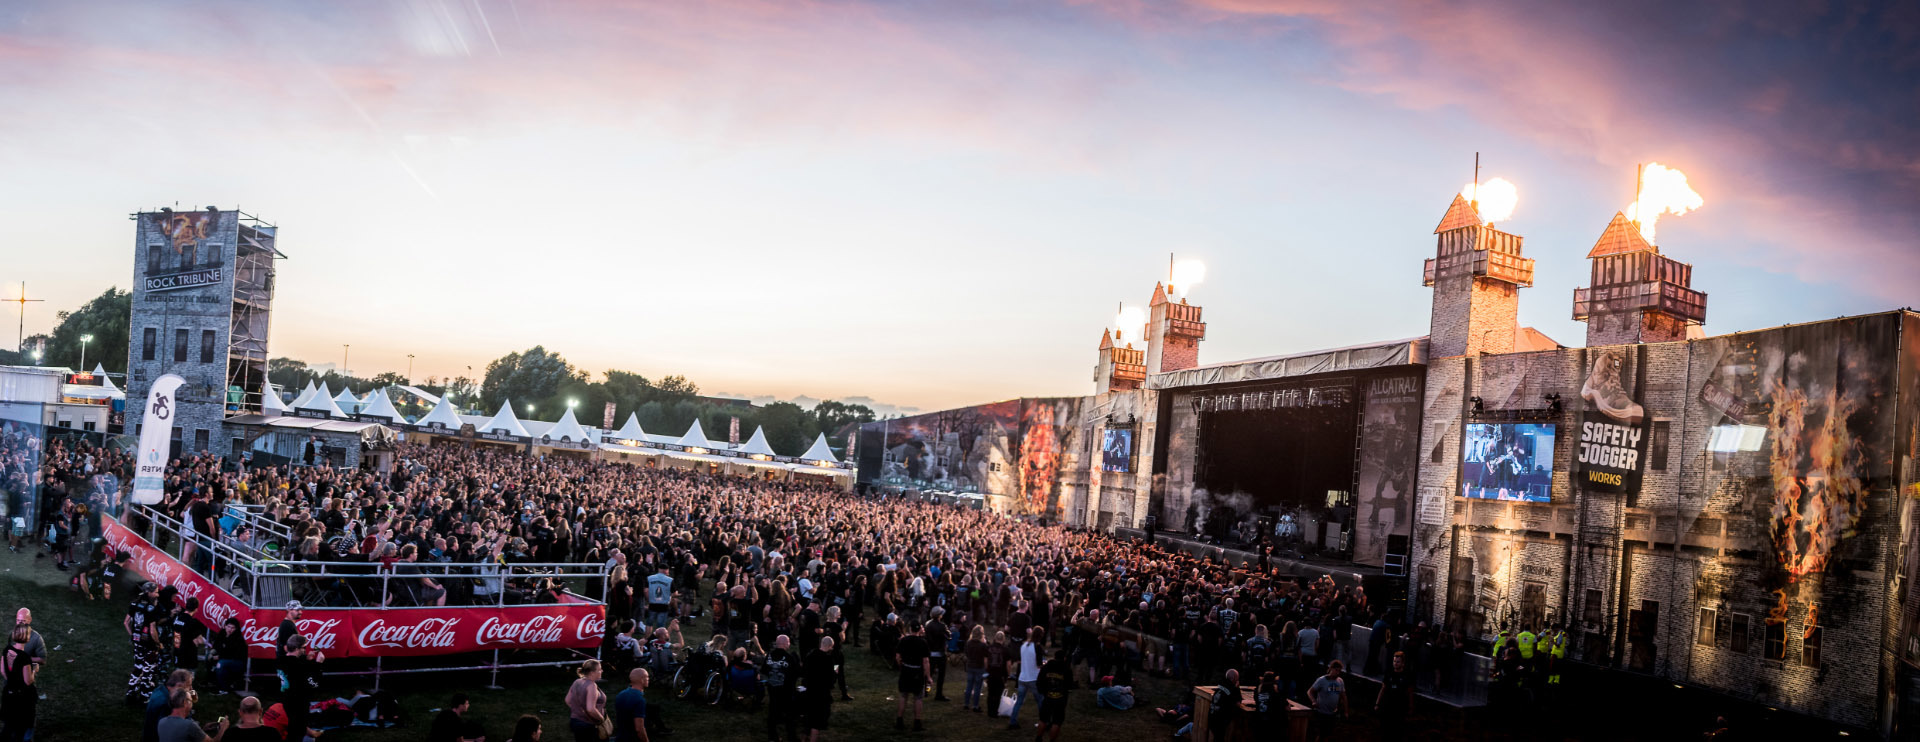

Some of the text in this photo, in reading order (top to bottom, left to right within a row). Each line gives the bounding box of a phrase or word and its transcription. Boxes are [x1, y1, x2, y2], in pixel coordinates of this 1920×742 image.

[147, 269, 220, 289] ROCK TRIBUNE
[1370, 376, 1418, 396] ALCATRAZ
[1581, 421, 1642, 448] SAFETY
[1578, 442, 1638, 471] JOGGER
[1589, 470, 1622, 486] WORKS
[358, 617, 462, 648] Coca-Cola
[476, 615, 567, 645] Coca-Cola
